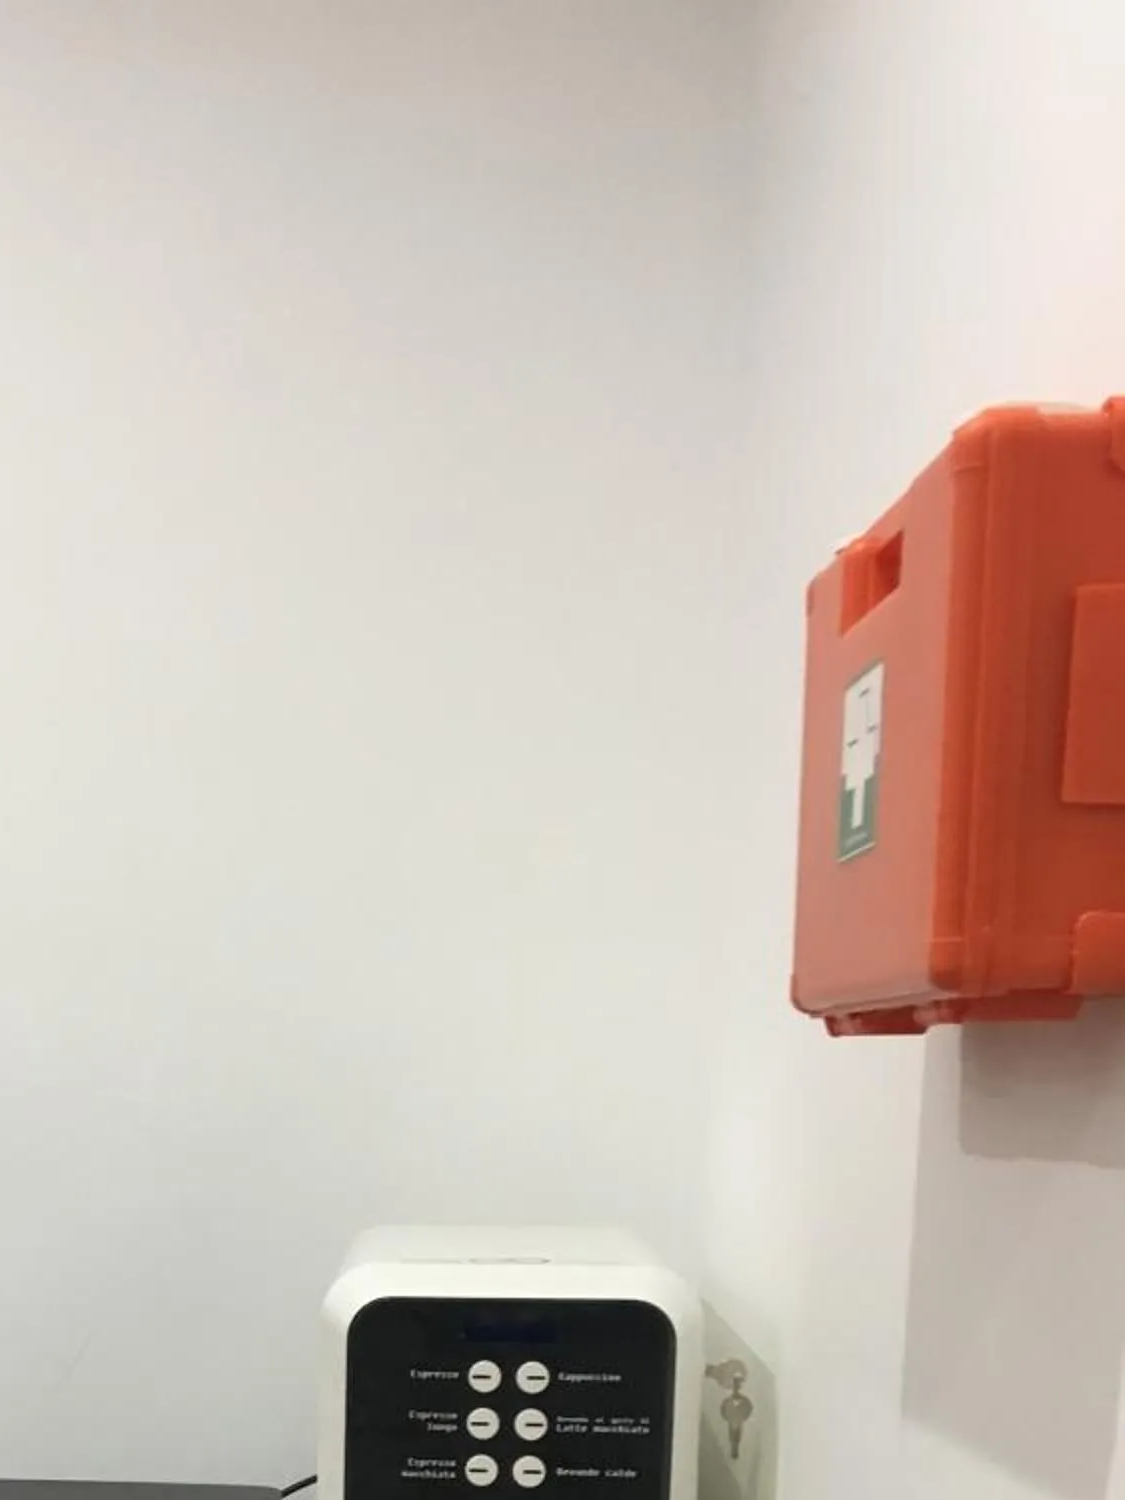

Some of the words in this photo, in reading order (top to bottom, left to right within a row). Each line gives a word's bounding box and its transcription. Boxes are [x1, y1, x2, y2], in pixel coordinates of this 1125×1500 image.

[410, 1369, 460, 1381] Espresso
[408, 1409, 458, 1421] Espresso
[407, 1457, 456, 1469] Espresso
